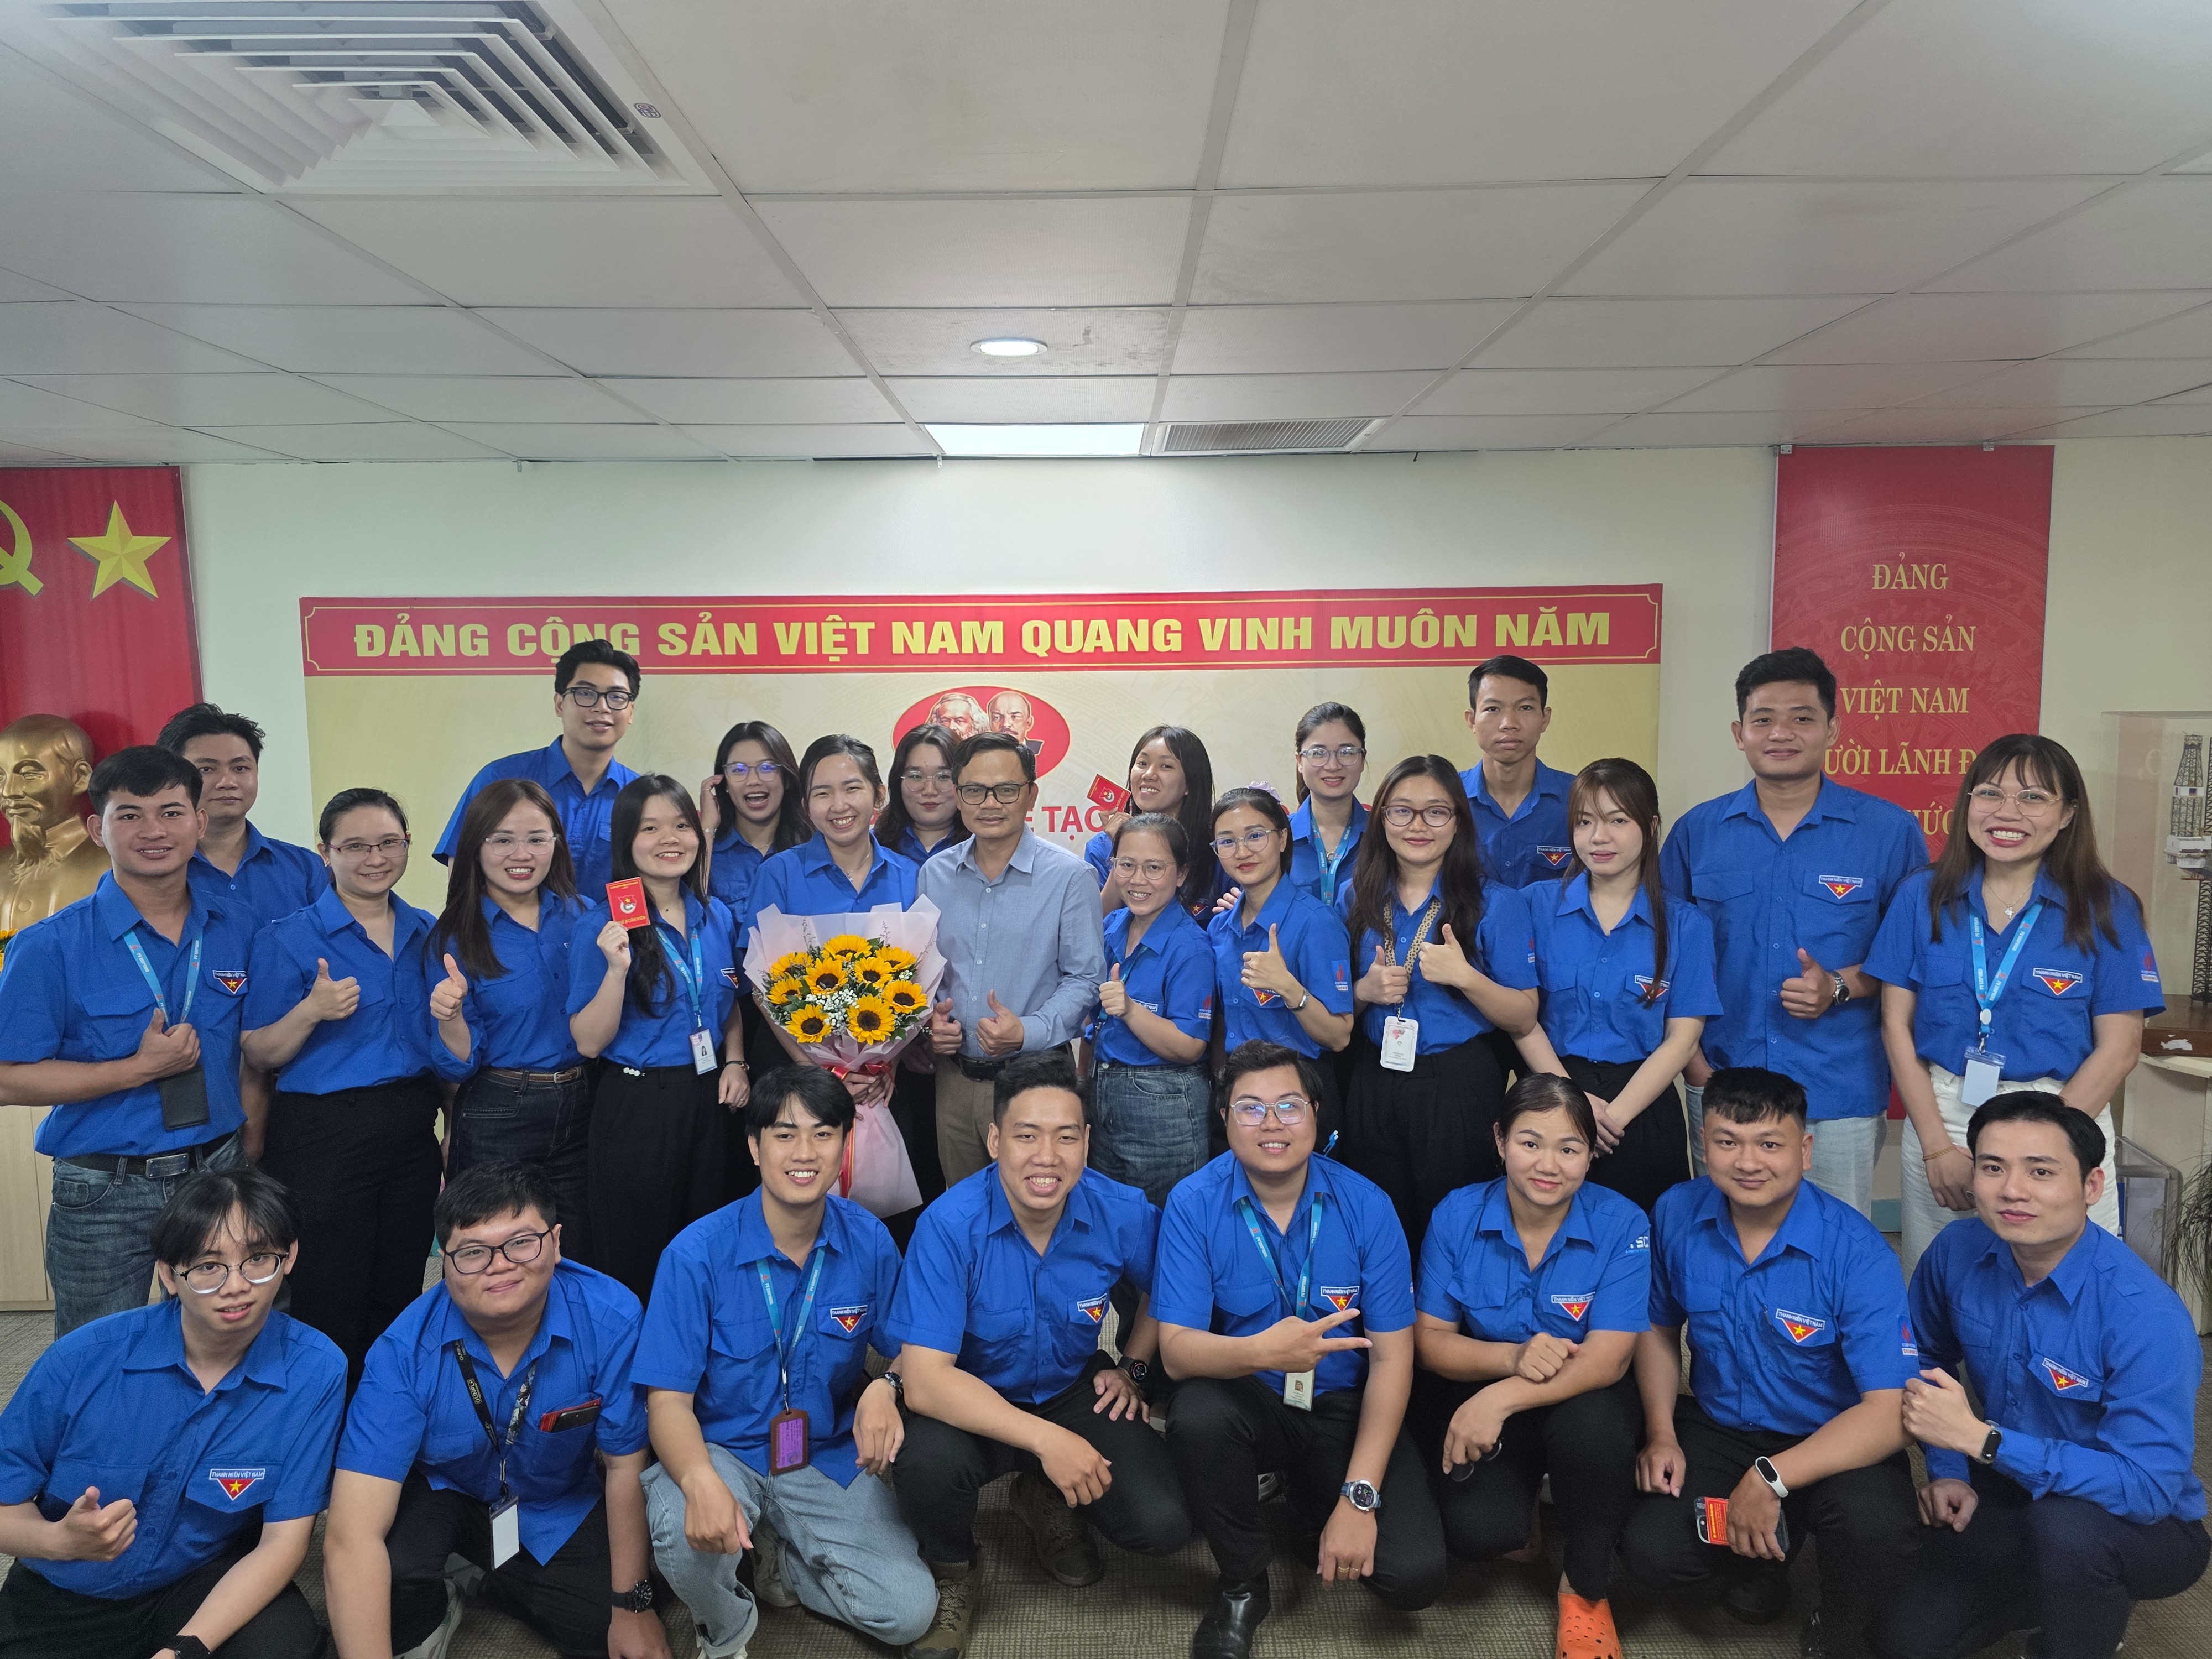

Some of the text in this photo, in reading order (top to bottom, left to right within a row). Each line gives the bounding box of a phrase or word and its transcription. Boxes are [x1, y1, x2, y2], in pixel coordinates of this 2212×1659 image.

[1872, 552, 1949, 590] ĐẢNG
[354, 613, 489, 657] ĐẢNG
[658, 611, 757, 656] SẢN
[773, 615, 875, 662] VIỆT
[892, 621, 1003, 655] NAM
[1021, 618, 1182, 657] QUANG
[1198, 617, 1312, 651] VINH
[1330, 608, 1477, 649] MUÔN
[1495, 606, 1609, 646] NĂM
[1841, 614, 1976, 659] CỘNG SẢN
[1840, 679, 1970, 721] VIỆT NAM
[1825, 738, 1871, 775] ƯỜI
[1878, 742, 1952, 774] LÃNH
[468, 1379, 480, 1403] GUNPLA
